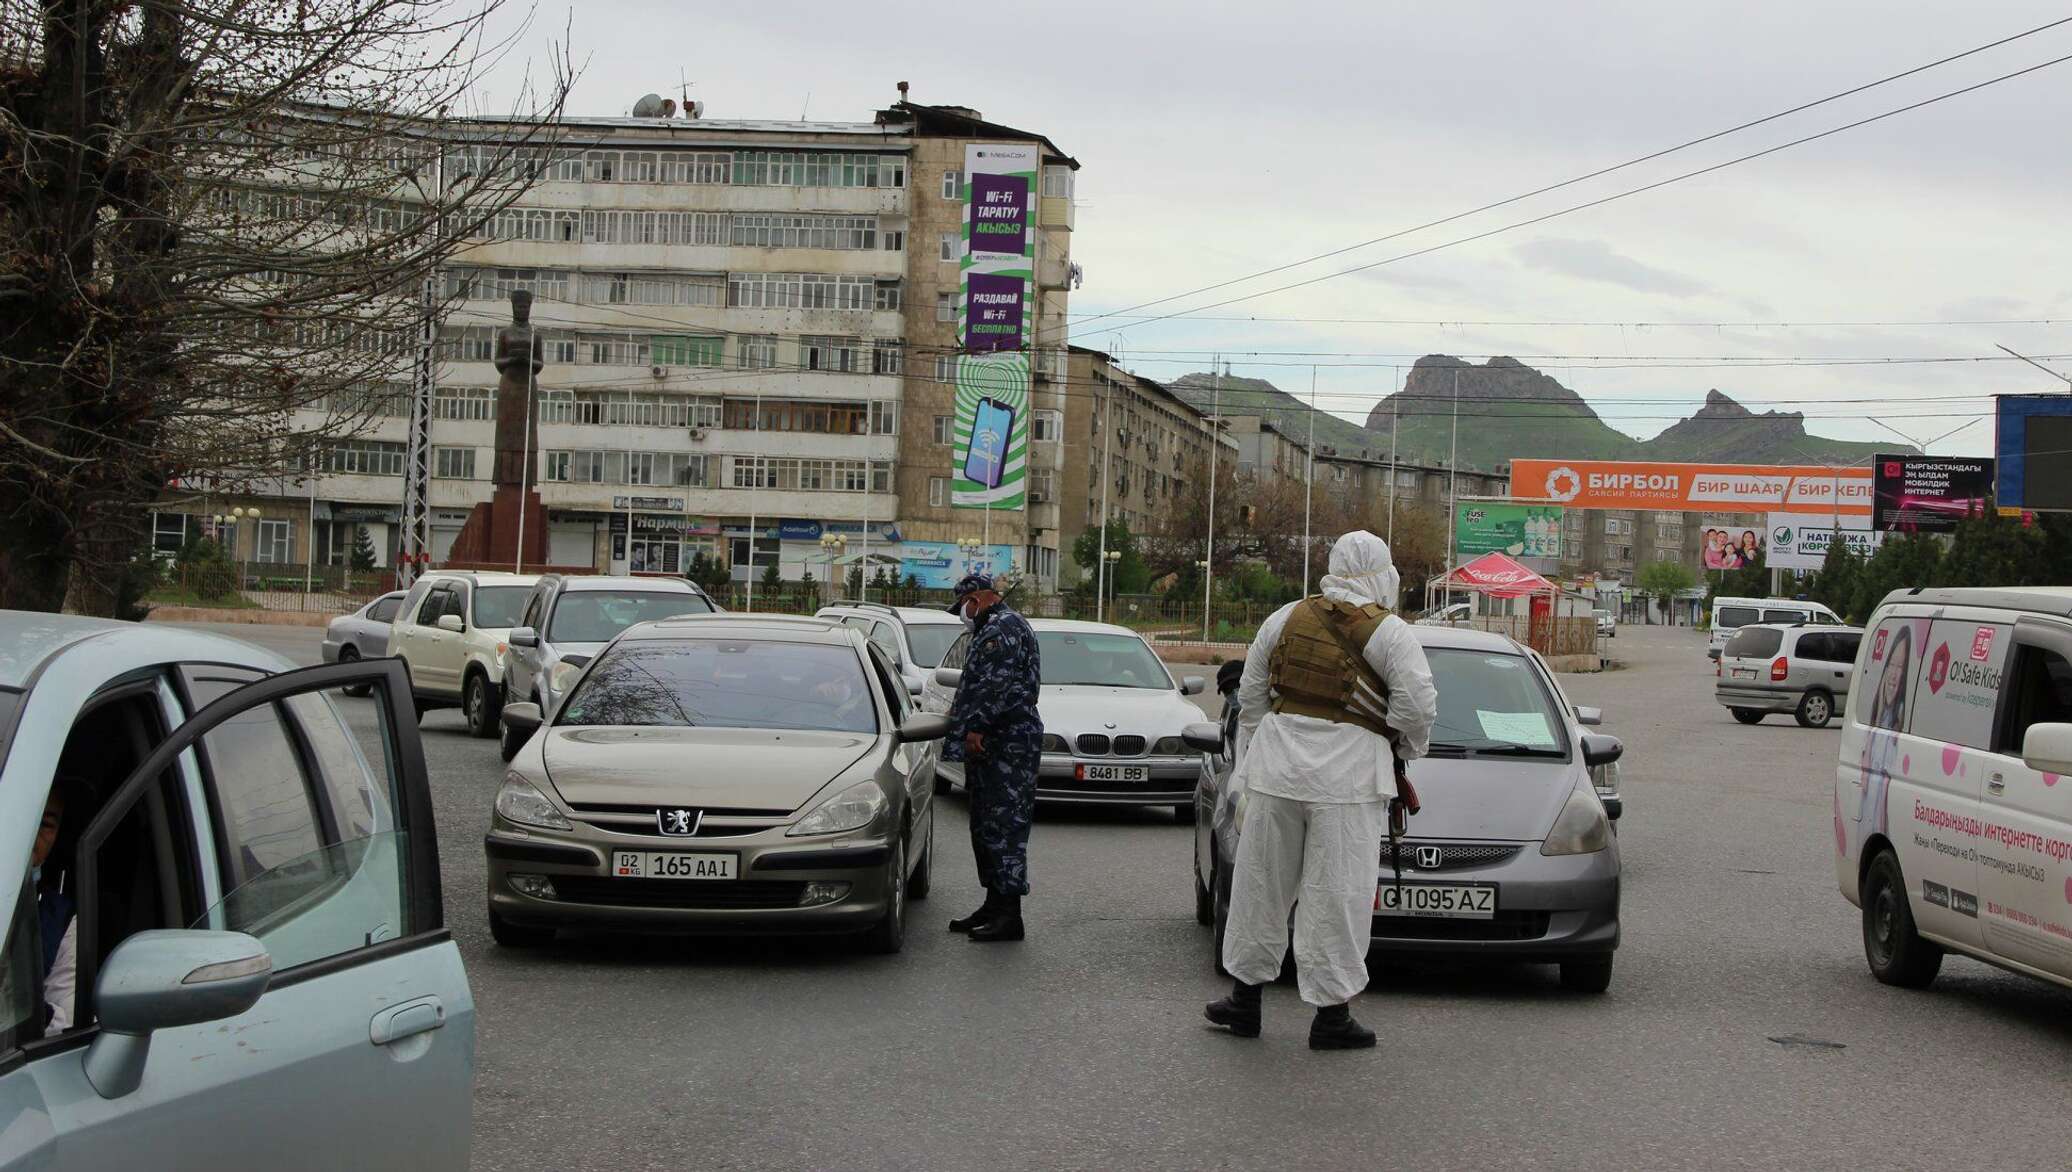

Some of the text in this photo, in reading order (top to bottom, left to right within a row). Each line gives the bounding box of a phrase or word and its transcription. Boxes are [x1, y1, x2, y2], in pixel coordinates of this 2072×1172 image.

[986, 191, 1013, 203] Wi-Fi
[978, 206, 1020, 219] ТАРАТУУ
[976, 222, 1021, 235] АКЫСЫЗ
[973, 293, 1018, 304] РАЗДАВАЙ
[983, 309, 1007, 320] Wi-Fi
[972, 324, 1017, 334] БЕСПЛАТНО
[1905, 463, 1982, 473] КЫРГЫЗСТАНДАГЫ
[1588, 473, 1679, 490] БИРБОЛ
[1918, 472, 1949, 480] ЫЛДАМ
[1697, 481, 1730, 494] БИР
[1734, 482, 1784, 495] ШААР
[1798, 484, 1831, 497] БИР
[1905, 480, 1950, 488] МОБИЛДИК
[1630, 490, 1679, 499] ПАРТИЯСЫ
[1904, 488, 1945, 496] ИНТЕРНЕТ
[1807, 533, 1867, 544] НАТЖА
[1961, 662, 1980, 686] Safe
[1980, 665, 2000, 690] Kids
[1089, 766, 1119, 780] 8481
[1914, 799, 1983, 837] Балдарыңызды
[1984, 822, 2043, 853] интернетте
[621, 854, 728, 877] 02 165 AAI
[630, 868, 641, 876] KG
[1405, 888, 1454, 911] 1095
[1458, 890, 1492, 911] AZ
